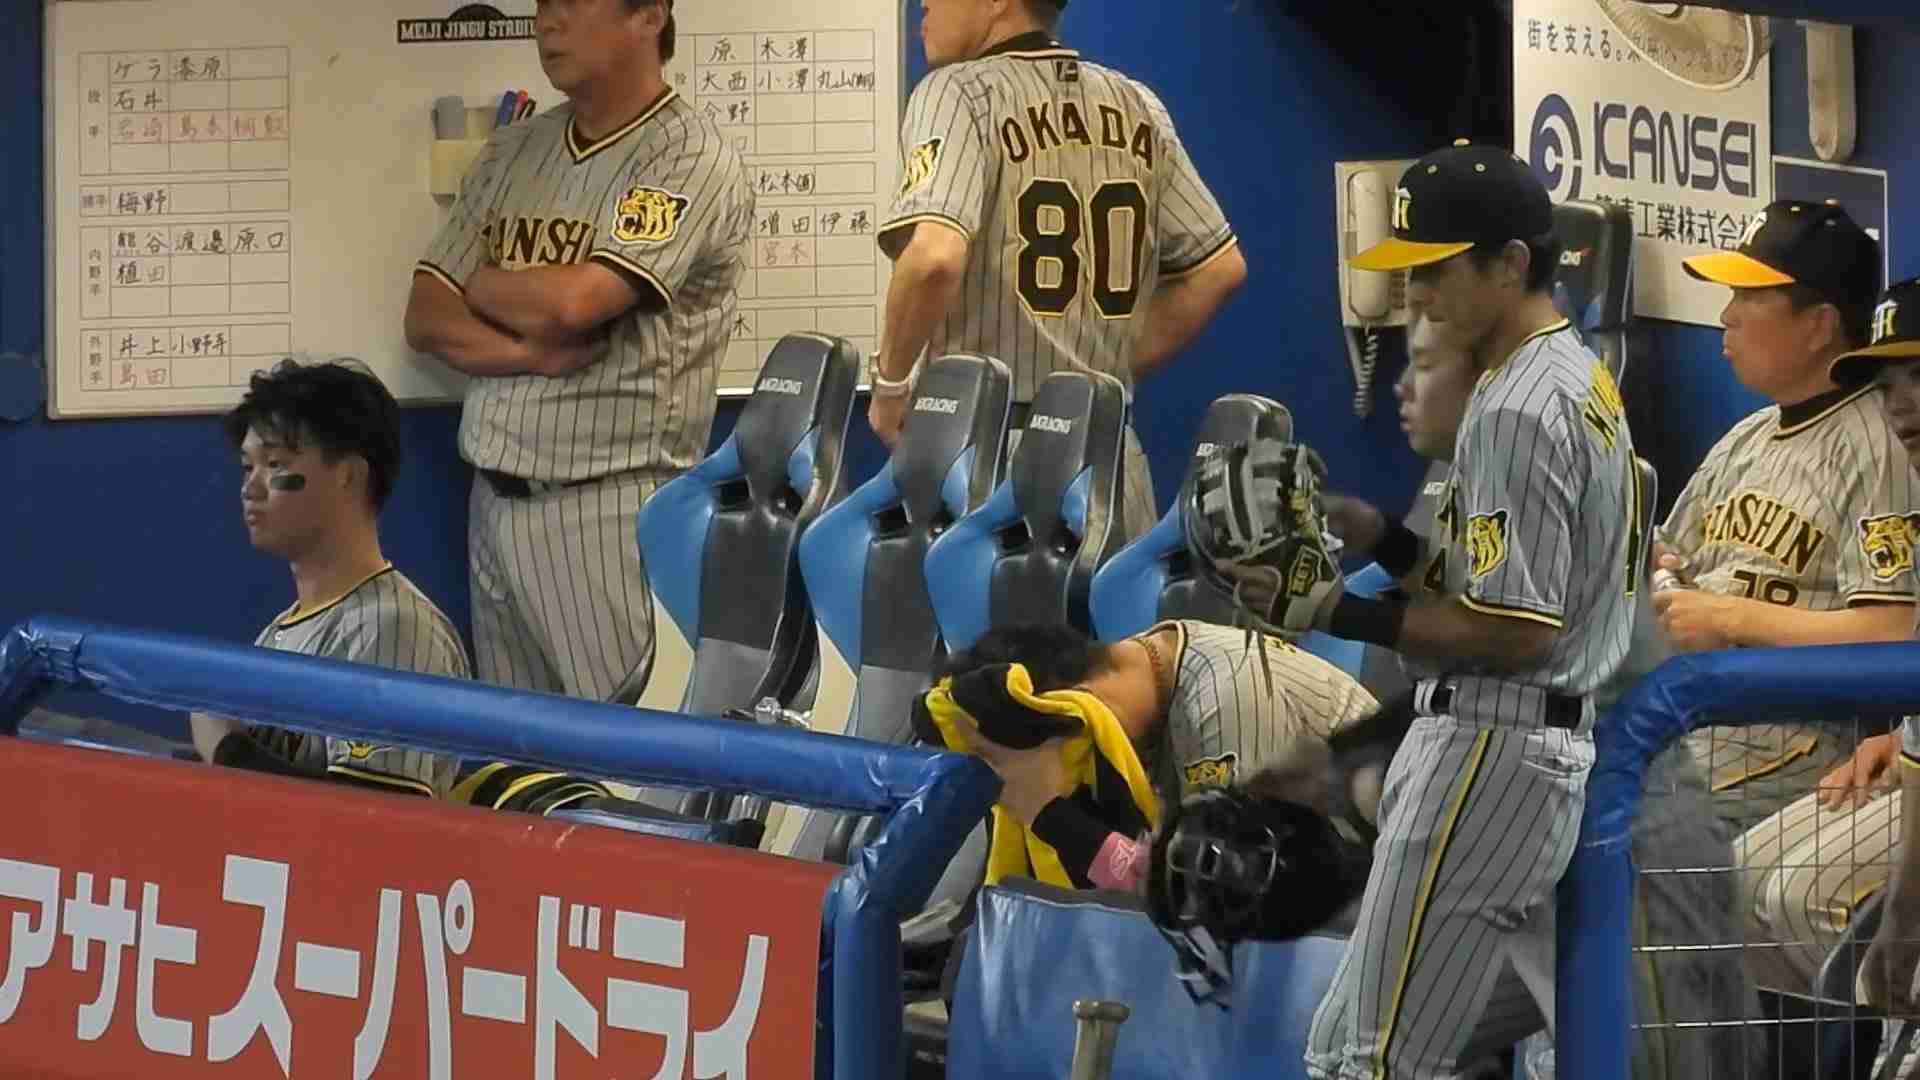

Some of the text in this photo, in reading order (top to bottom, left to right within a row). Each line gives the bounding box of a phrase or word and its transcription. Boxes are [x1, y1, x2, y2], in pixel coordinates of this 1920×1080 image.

[401, 22, 442, 40] MEIJI
[444, 20, 486, 39] JINGU
[708, 37, 736, 62] 原
[702, 70, 747, 91] 大西
[114, 89, 163, 110] 石井
[1001, 102, 1153, 168] OKADA
[1016, 177, 1147, 319] 80
[120, 333, 165, 356] 井上
